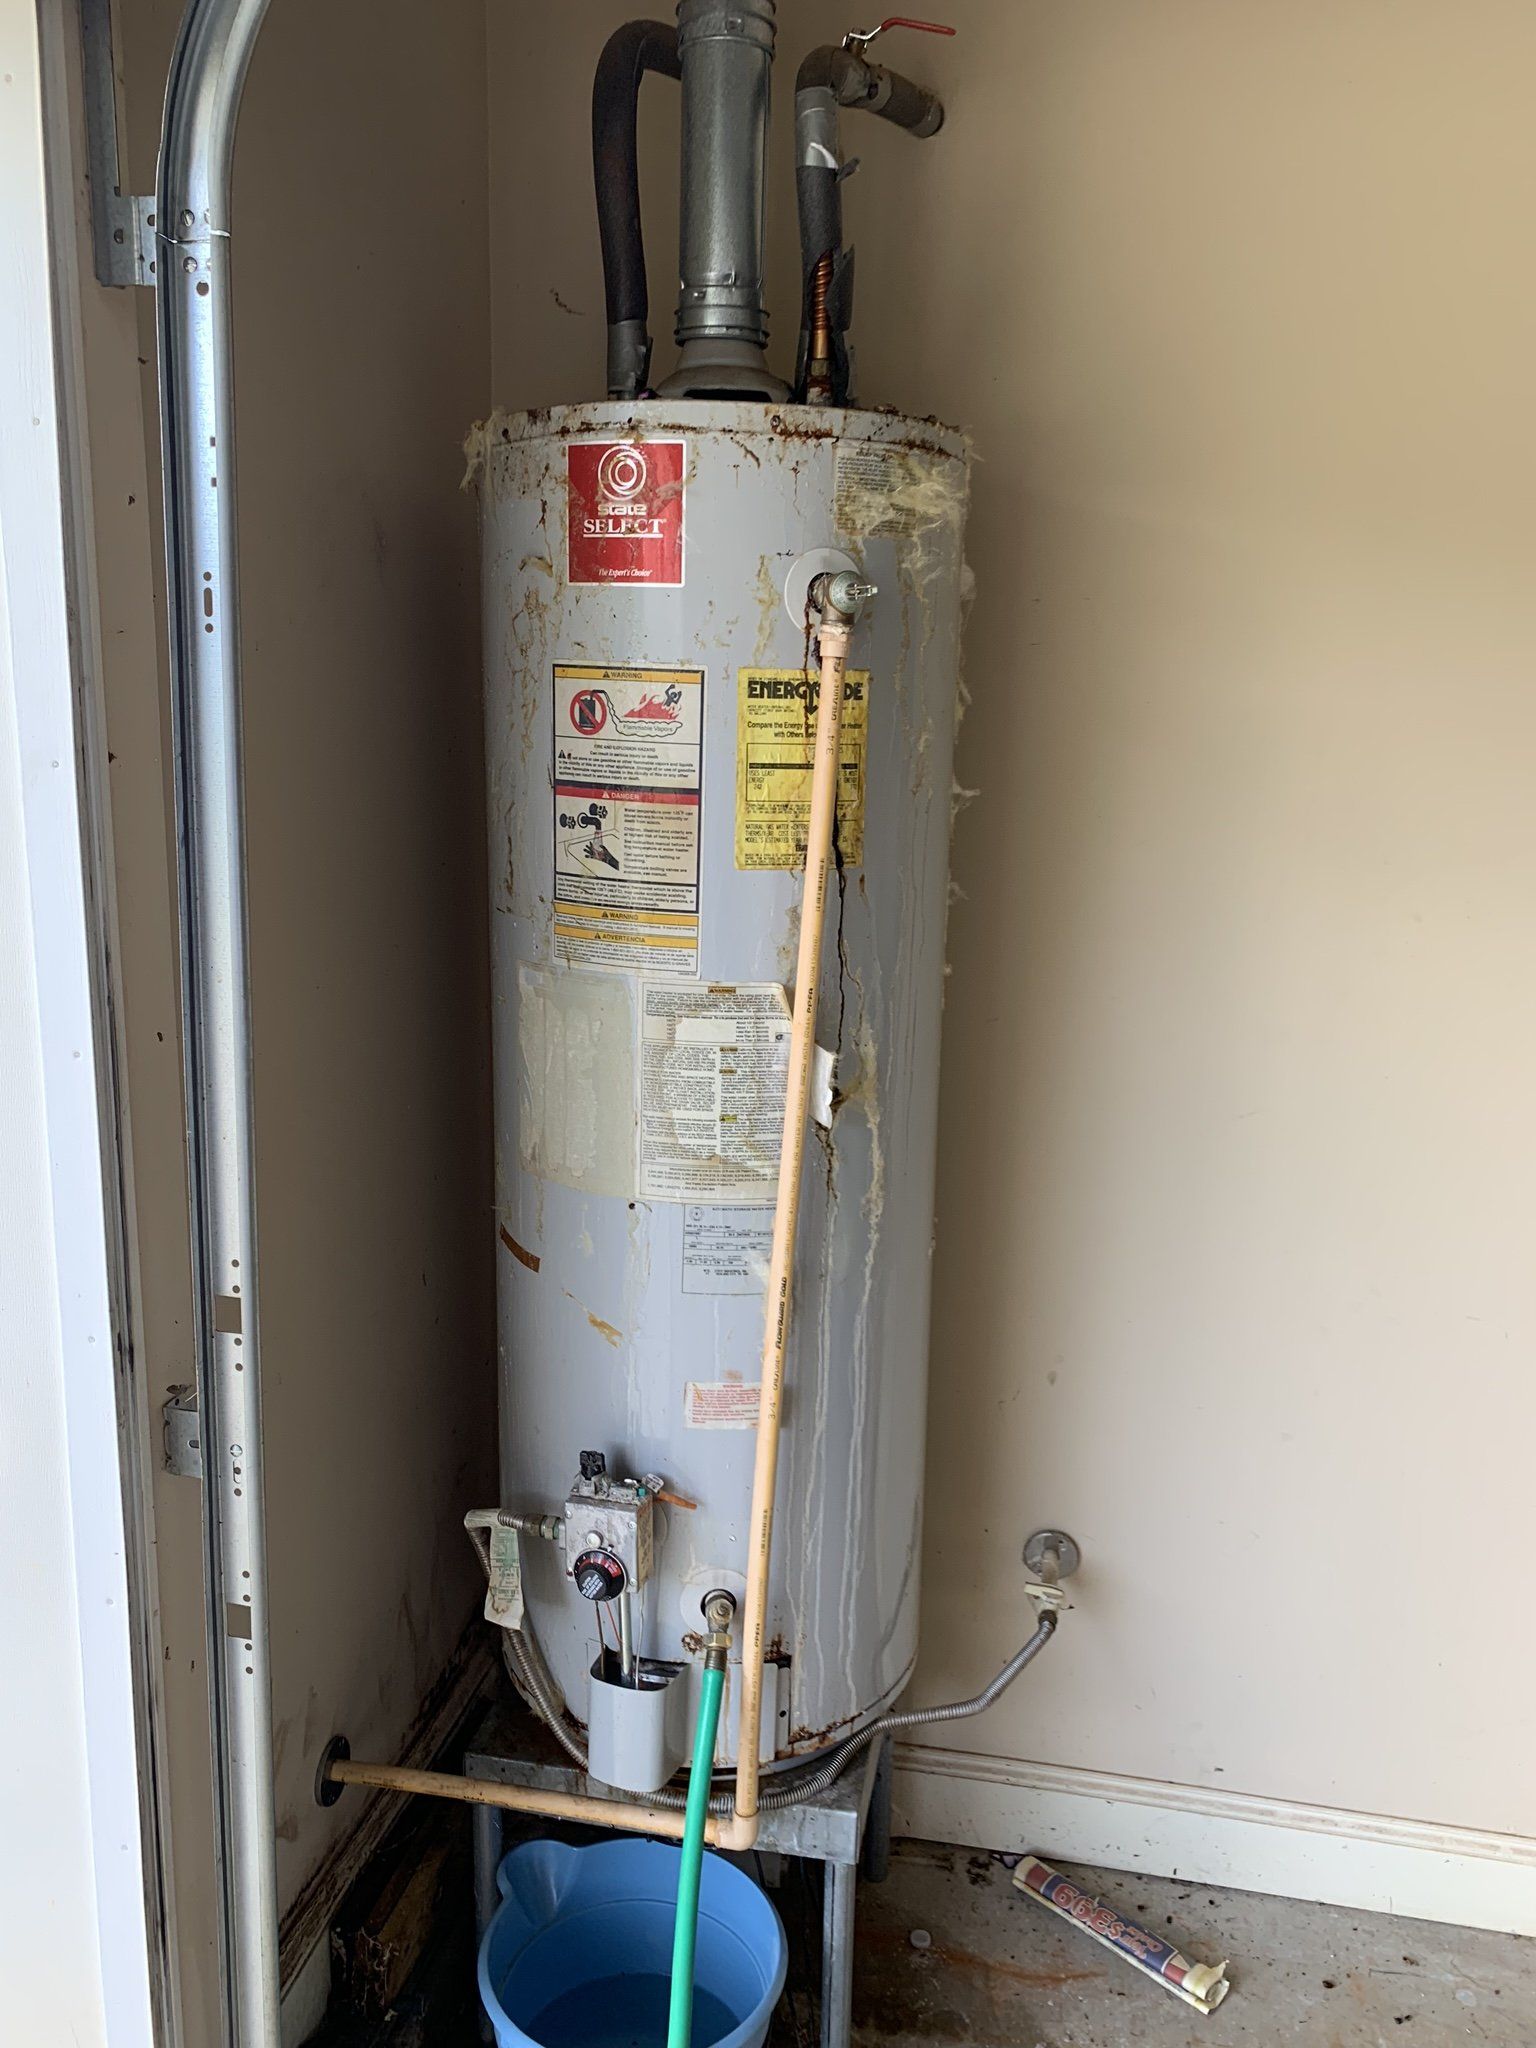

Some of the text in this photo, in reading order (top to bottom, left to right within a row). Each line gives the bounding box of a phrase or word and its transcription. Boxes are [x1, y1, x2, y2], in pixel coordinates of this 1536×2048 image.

[598, 504, 646, 516] state
[583, 518, 664, 534] SELECT
[747, 721, 773, 730] Compare
[784, 721, 803, 730] Energy
[611, 792, 640, 800] DANGER
[609, 912, 639, 920] WARNING
[602, 933, 646, 943] ADVERTENCIA
